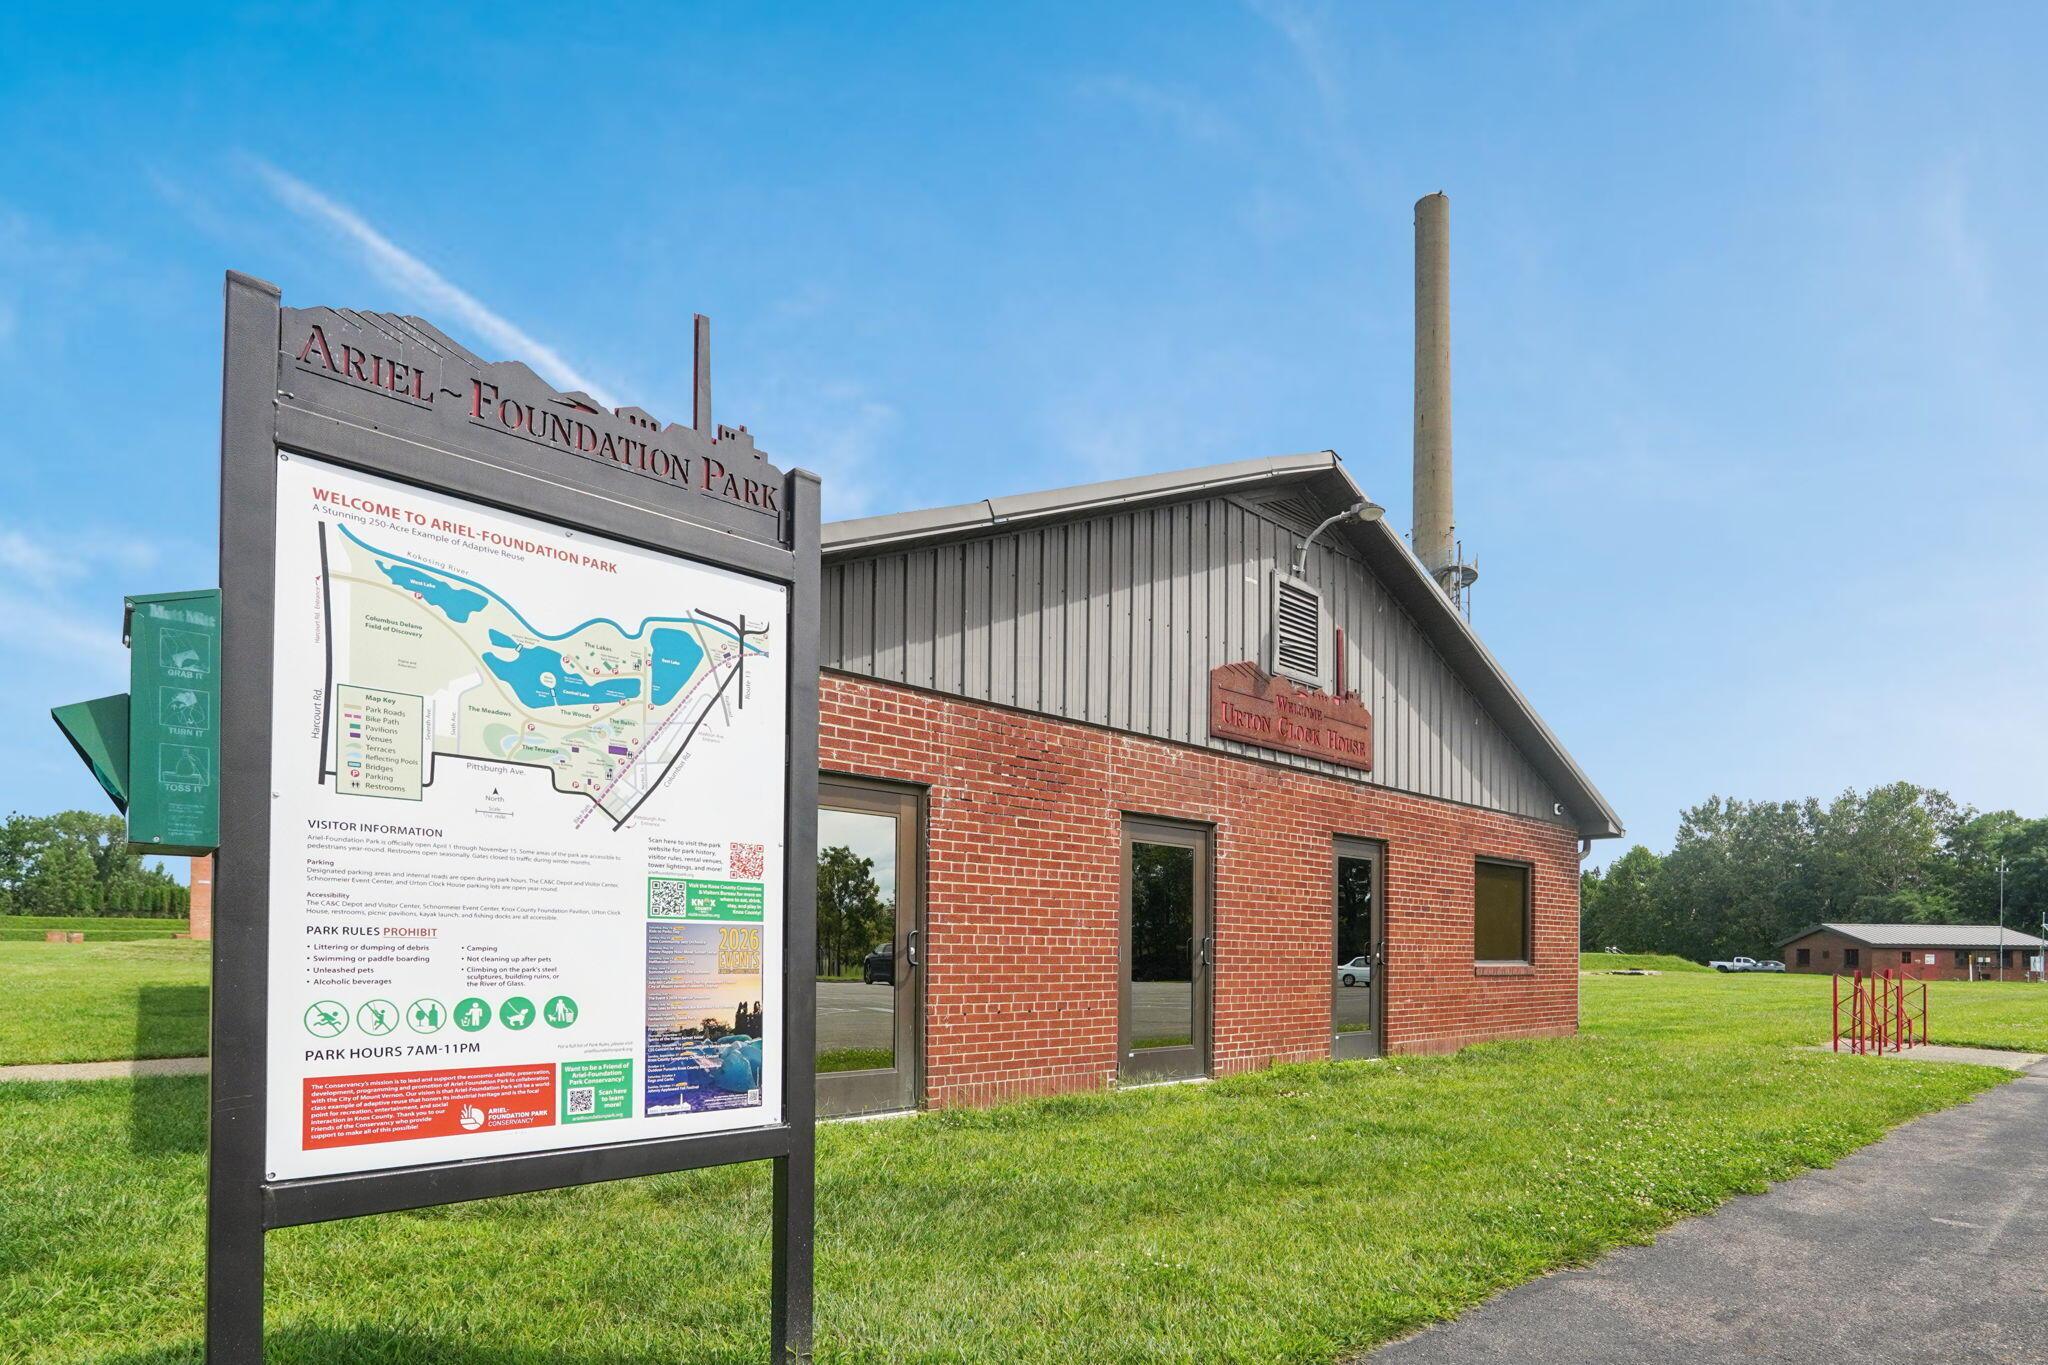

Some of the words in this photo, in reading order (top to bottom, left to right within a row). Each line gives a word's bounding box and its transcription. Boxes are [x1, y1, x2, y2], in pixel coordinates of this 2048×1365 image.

[700, 456, 778, 511] PARK
[312, 487, 400, 520] WELCOME
[430, 517, 578, 564] ARIEL-FOUNDATION
[582, 555, 616, 574] PARK
[322, 505, 366, 525] Stunning
[369, 517, 409, 534] 250-Acre
[411, 527, 449, 544] Example
[462, 540, 499, 556] Adaptive
[501, 549, 524, 562] Reuse
[406, 550, 446, 569] Kokosing
[448, 563, 470, 576] River
[365, 614, 398, 625] Columbus
[399, 620, 422, 630] Delano
[364, 622, 381, 630] Field
[390, 626, 422, 638] Discovery
[596, 644, 612, 652] Lakes
[167, 669, 193, 678] GRAB
[195, 671, 204, 679] IT
[744, 669, 751, 678] 13
[312, 686, 323, 701] Rd.
[365, 694, 381, 703] Map
[382, 697, 396, 705] Key
[365, 705, 381, 713] Park
[383, 707, 406, 717] Roads
[481, 707, 511, 717] Meadows
[1276, 694, 1322, 721] WELCOME
[311, 700, 322, 739] Harcourt
[365, 715, 381, 723] Bike
[382, 717, 399, 725] Path
[168, 727, 193, 736] TURN
[195, 728, 204, 737] IT
[365, 724, 398, 734] Pavilions
[1221, 701, 1271, 734] URTON
[1278, 717, 1321, 746] CLOCK
[1327, 728, 1366, 757] HOUSE
[365, 734, 392, 743] Venues
[365, 744, 396, 753] Terraces
[534, 745, 558, 754] Terraces
[365, 754, 399, 764] Reflecting
[400, 757, 418, 765] Pools
[365, 763, 393, 773] Bridges
[466, 762, 508, 774] Pittsburgh
[509, 767, 525, 775] Ave.
[663, 756, 686, 790] Columbus
[365, 772, 393, 782] Parking
[165, 784, 191, 792] TOSS
[193, 785, 203, 793] IT
[365, 782, 405, 792] Restrooms
[307, 819, 356, 831] VISITOR
[360, 823, 442, 837] INFORMATION
[306, 858, 334, 866] Parking
[666, 863, 693, 871] lightings,
[306, 892, 350, 900] Accessibility
[306, 925, 338, 934] PARK
[342, 926, 380, 935] RULES
[383, 927, 437, 936] PROHIBIT
[719, 927, 759, 950] 2026
[360, 944, 395, 952] dumping
[312, 955, 356, 963] Swimming
[718, 951, 759, 967] EVENTS
[305, 1048, 345, 1061] PARK
[349, 1045, 402, 1059] HOURS
[406, 1042, 480, 1055] 7AM-11PM
[572, 1069, 621, 1078] Ariel-Foundation
[583, 1076, 624, 1084] Conservancy?
[488, 1111, 529, 1120] FOUNDATION
[488, 1116, 533, 1127] CONSERVANCY
